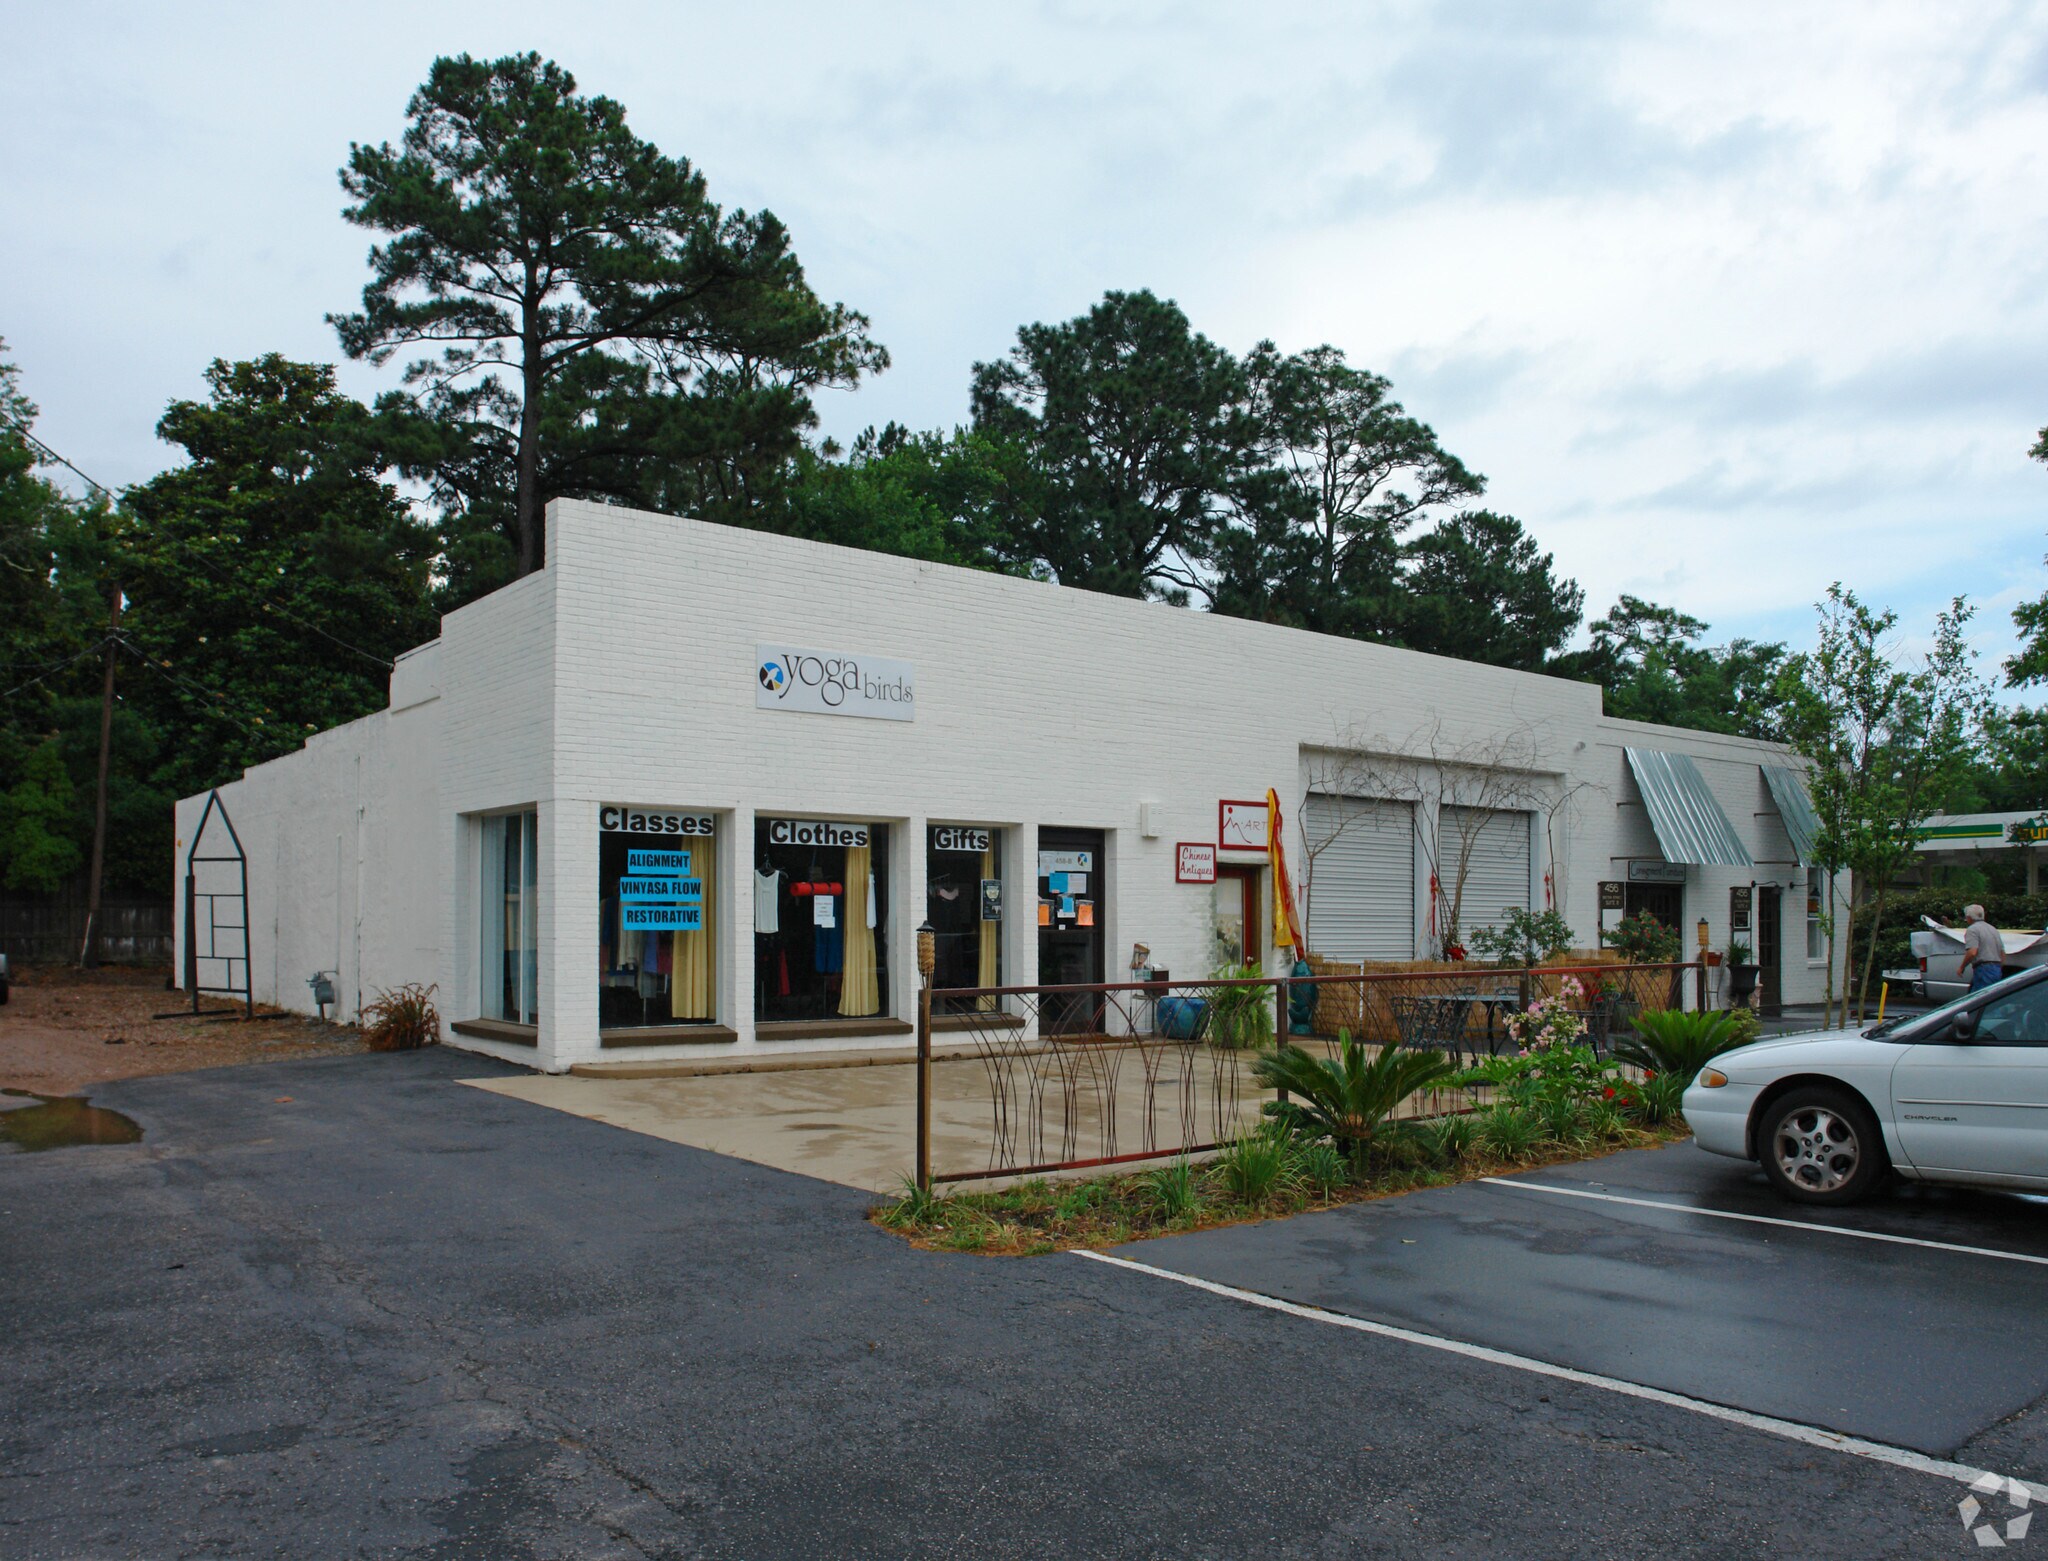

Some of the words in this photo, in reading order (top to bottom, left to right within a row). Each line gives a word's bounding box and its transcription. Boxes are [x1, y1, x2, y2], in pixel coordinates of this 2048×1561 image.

[779, 654, 861, 706] yoga
[864, 672, 914, 703] birds
[600, 807, 713, 834] Classes
[771, 821, 868, 846] Clothes
[935, 828, 989, 850] Gifts
[629, 854, 690, 868] ALIGNMENT
[1182, 847, 1211, 860] Chinese
[1180, 861, 1213, 880] Antiques
[621, 881, 669, 895] VINYASA
[671, 882, 702, 895] FLOW
[1604, 883, 1619, 893] 456
[626, 909, 700, 923] RESTORATIVE
